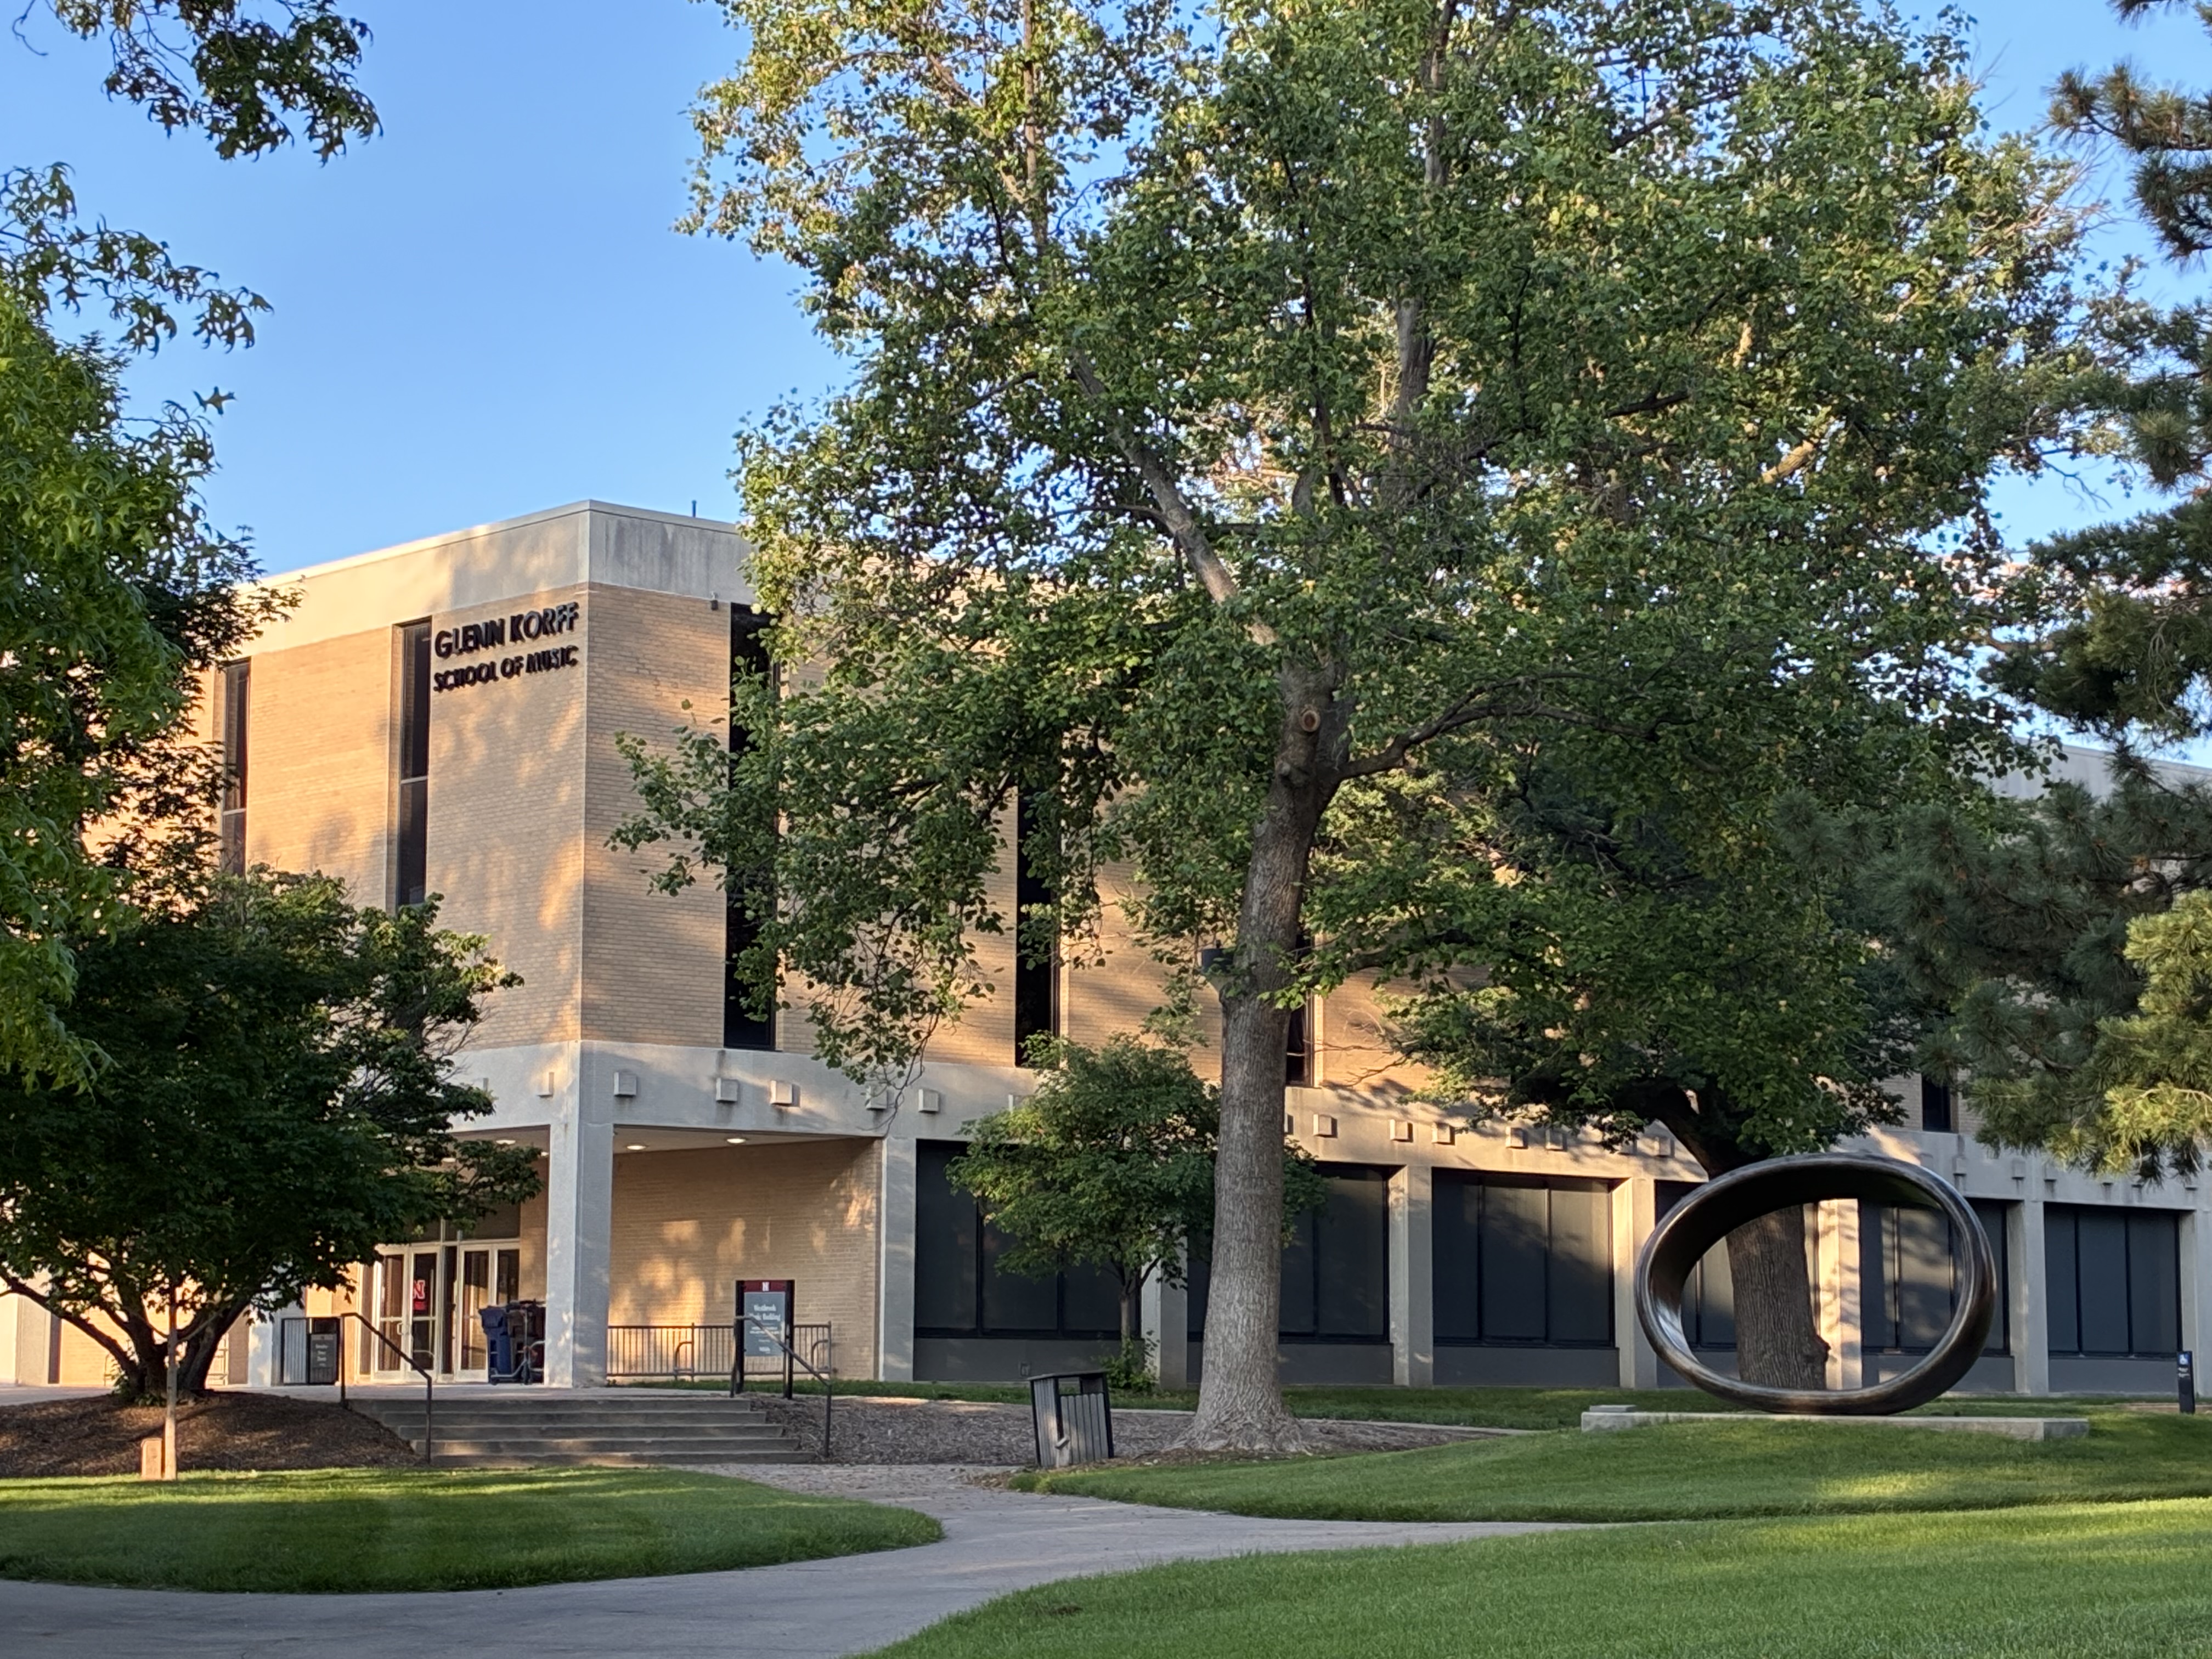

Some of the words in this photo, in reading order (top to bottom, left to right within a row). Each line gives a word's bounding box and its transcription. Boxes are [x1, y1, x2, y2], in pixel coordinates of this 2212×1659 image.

[435, 619, 505, 658] GLENN
[510, 602, 579, 642] KORFF
[433, 662, 500, 692] SCHOOL
[500, 656, 524, 679] OF
[526, 645, 579, 674] MUSIC
